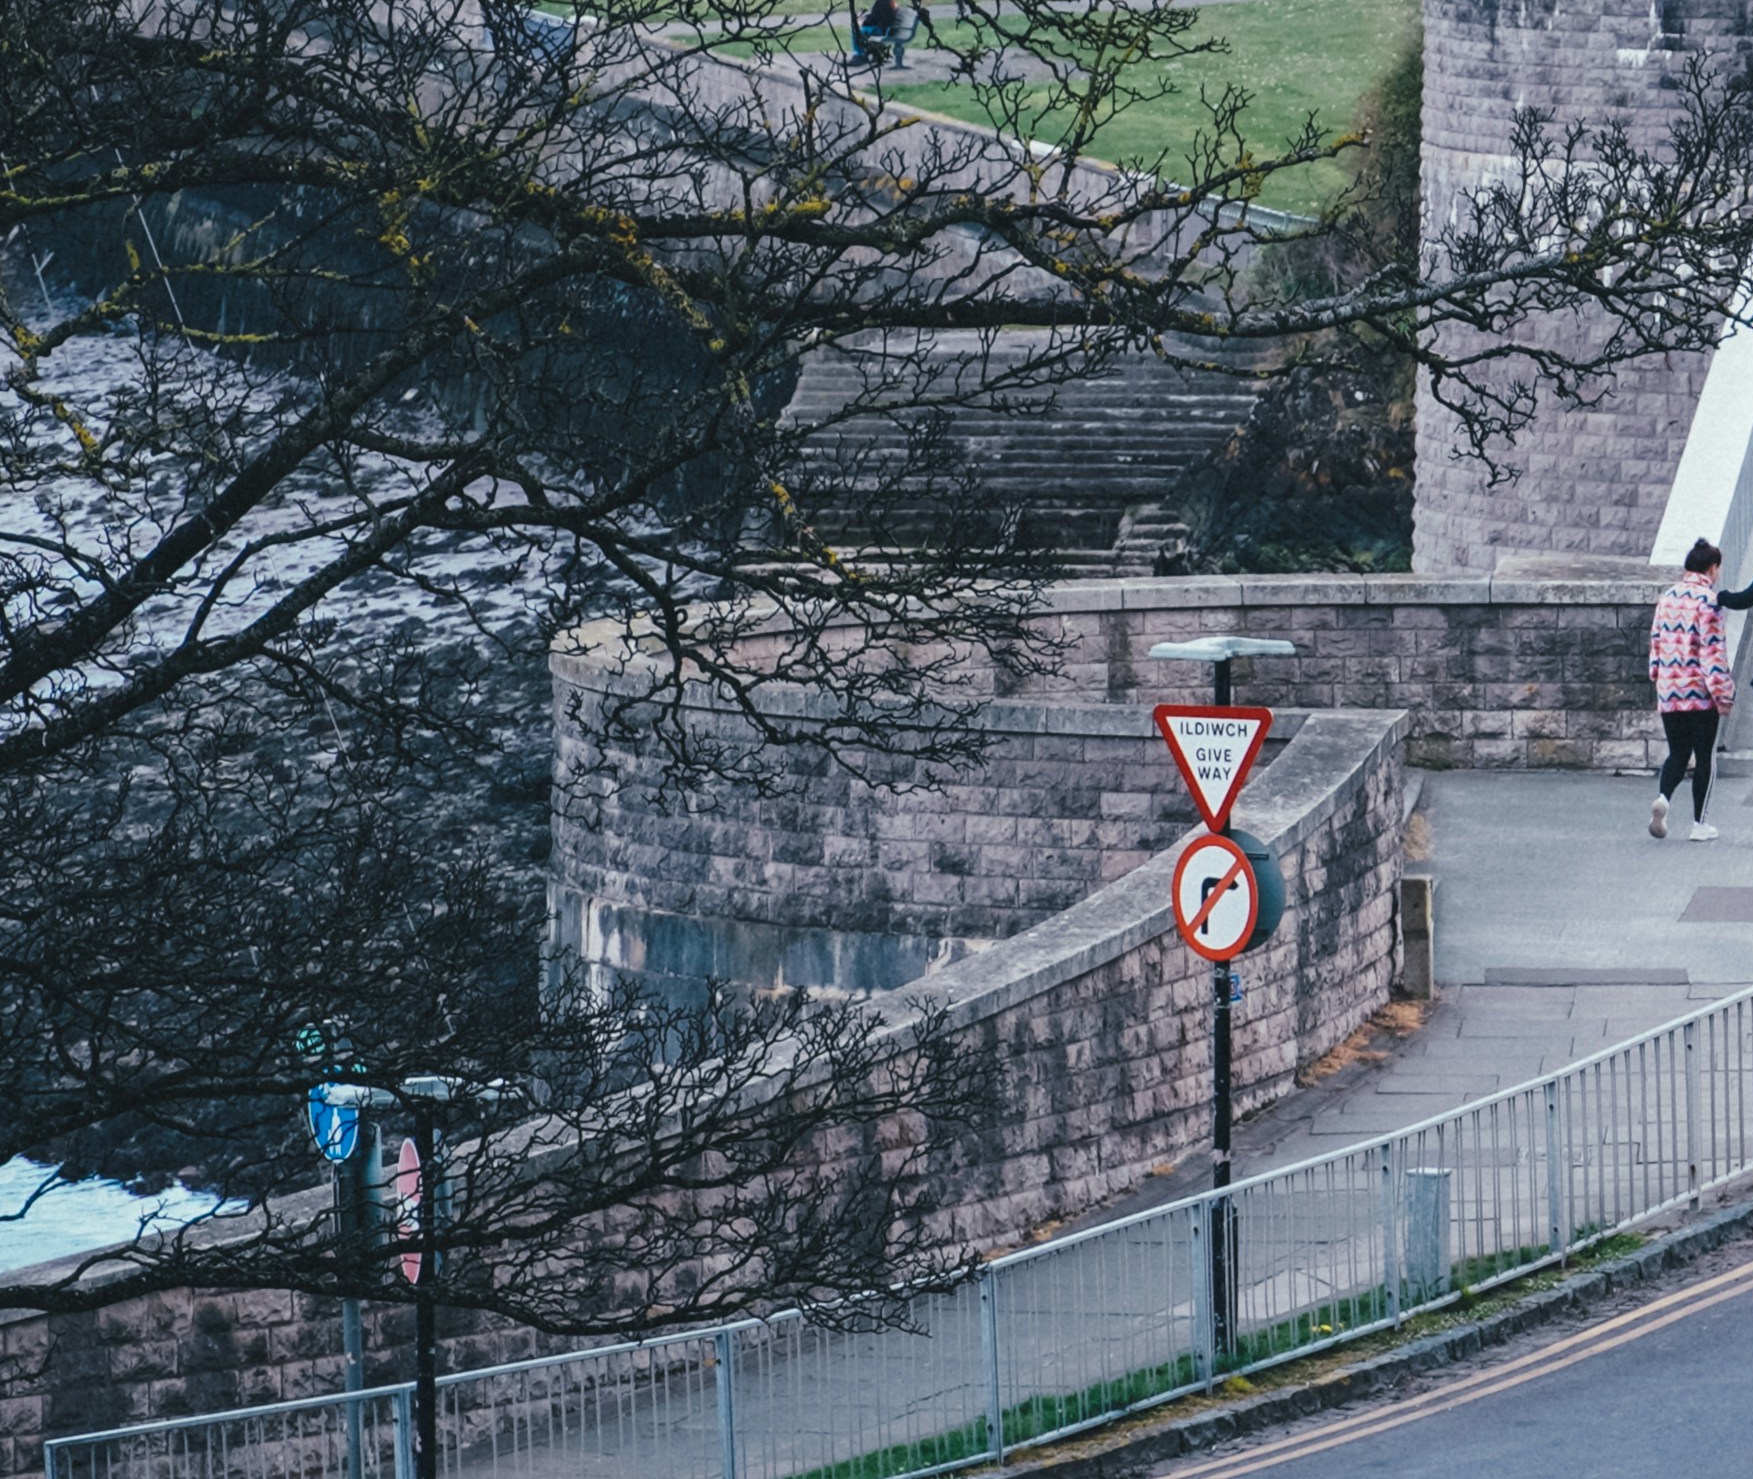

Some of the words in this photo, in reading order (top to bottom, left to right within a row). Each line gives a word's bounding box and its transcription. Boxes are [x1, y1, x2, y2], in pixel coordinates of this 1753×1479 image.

[1179, 721, 1248, 738] ILDIWCH
[1196, 748, 1233, 763] GIVE
[1197, 766, 1233, 781] WAY
